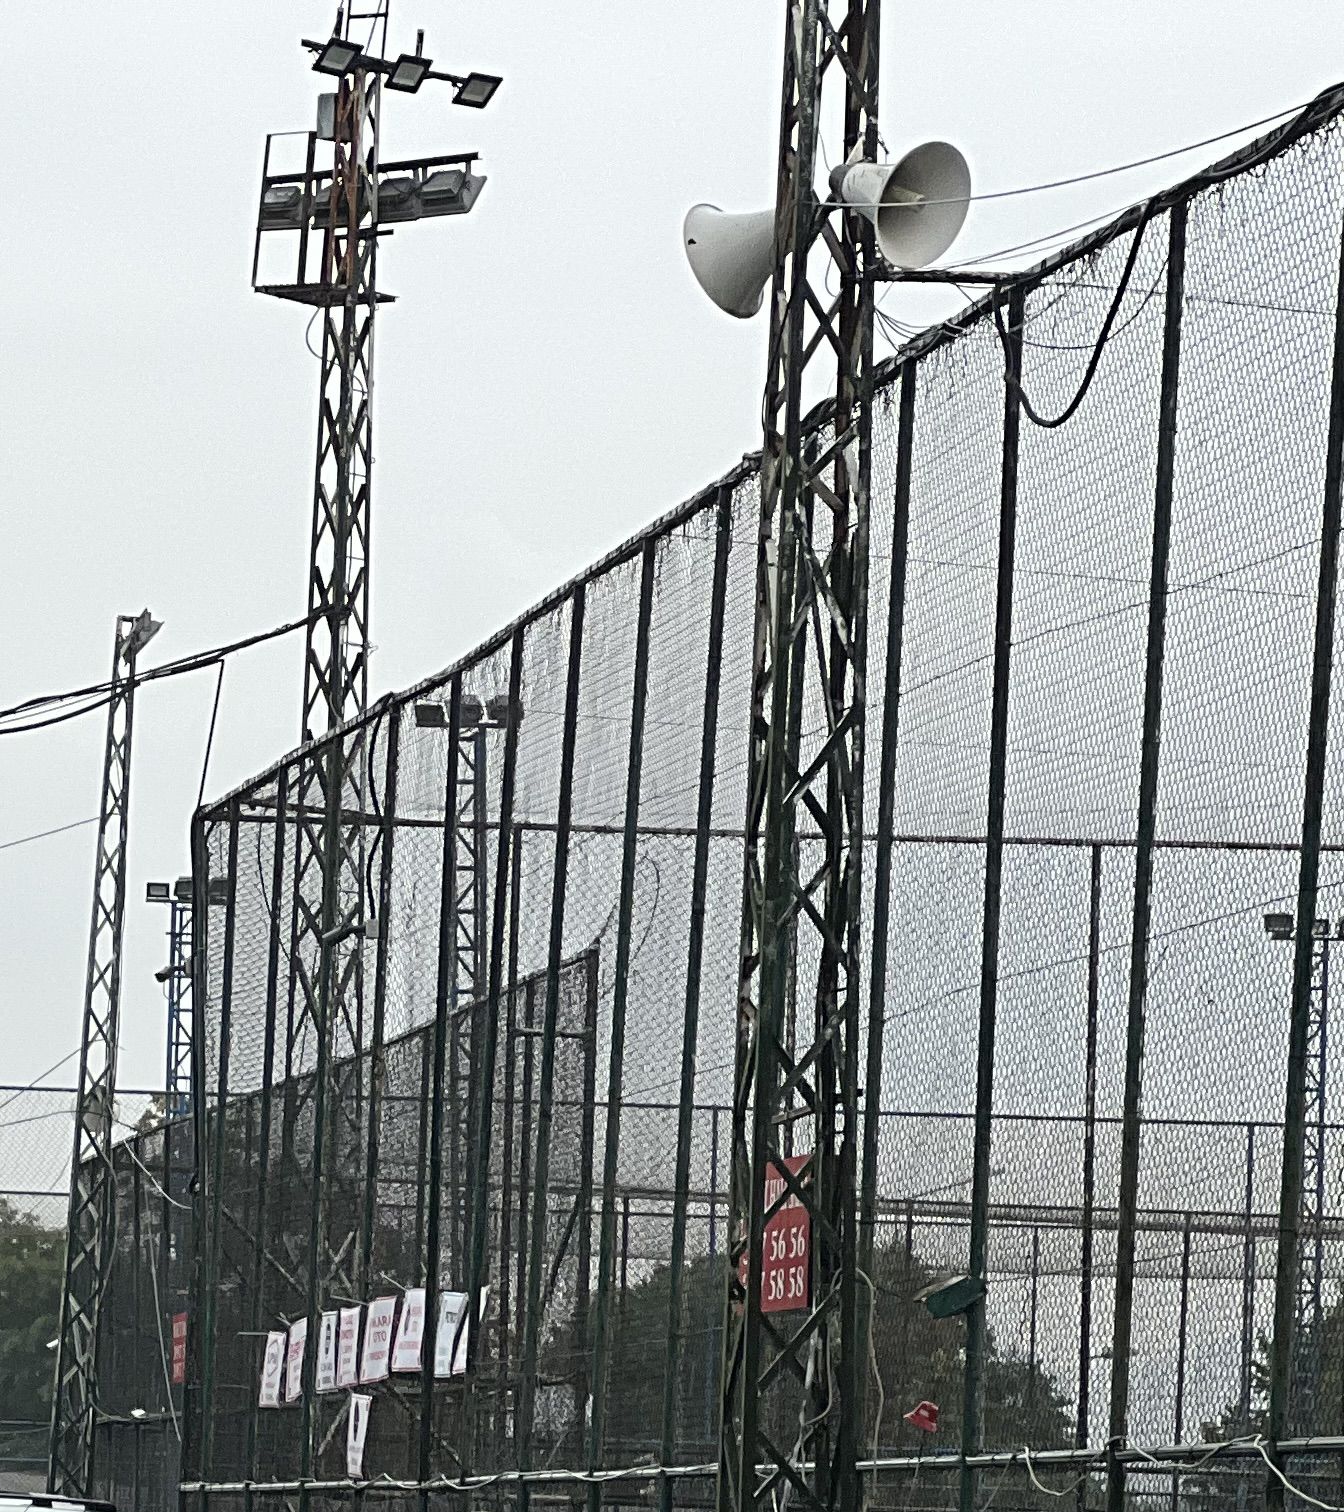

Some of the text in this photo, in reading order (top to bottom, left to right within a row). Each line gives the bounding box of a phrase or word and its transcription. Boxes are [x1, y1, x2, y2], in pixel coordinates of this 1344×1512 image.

[769, 1224, 806, 1261] 56 56
[768, 1265, 804, 1300] 58 58
